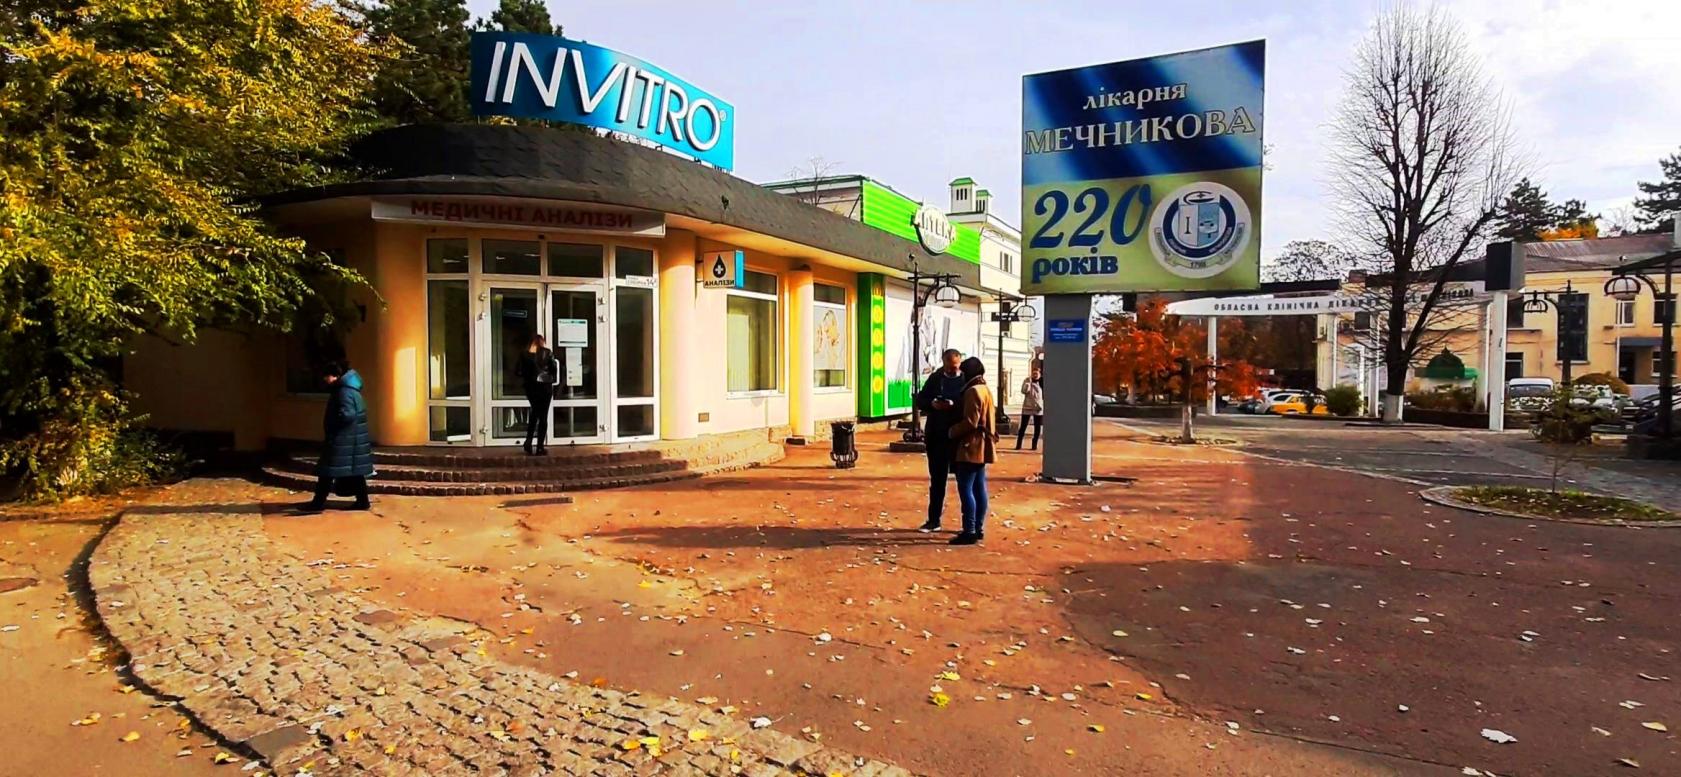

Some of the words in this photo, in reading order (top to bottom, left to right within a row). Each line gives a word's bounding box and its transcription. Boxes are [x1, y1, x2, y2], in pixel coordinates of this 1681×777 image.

[1083, 83, 1188, 111] лікарня
[1025, 106, 1257, 155] МЕЧНИКОВА
[411, 199, 526, 222] МЕДИЧНІ
[532, 207, 634, 229] АНАЛІЗИ
[1029, 183, 1153, 249] 220
[1031, 246, 1119, 284] років
[1214, 303, 1260, 311] ОБЛАСНА
[1267, 301, 1319, 311] КЛІНІЧНА
